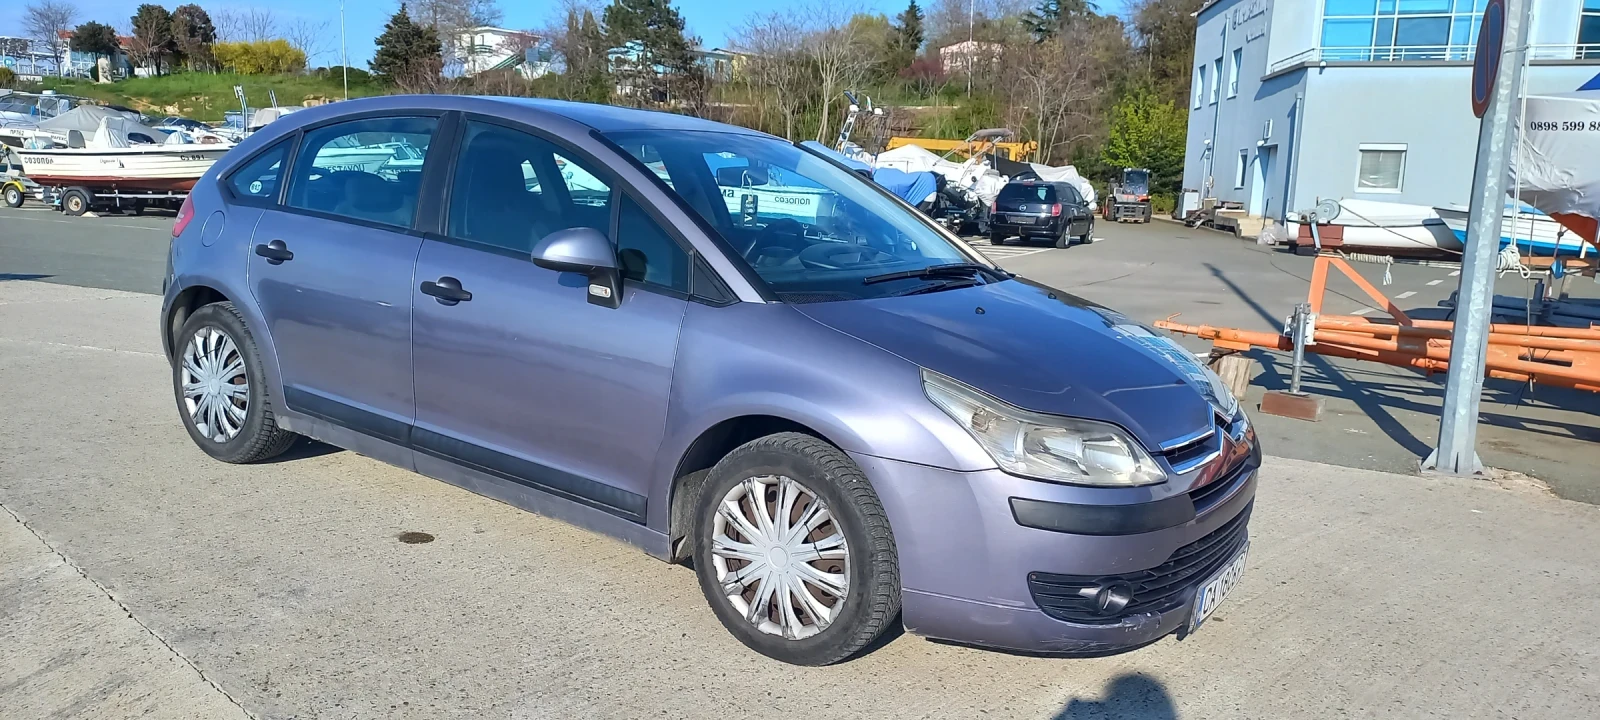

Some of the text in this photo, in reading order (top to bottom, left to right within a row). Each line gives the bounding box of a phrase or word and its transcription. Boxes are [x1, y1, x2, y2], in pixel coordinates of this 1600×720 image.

[1530, 121, 1558, 131] 0898
[1562, 121, 1584, 131] 599
[24, 157, 54, 165] СОЗОПОЛ
